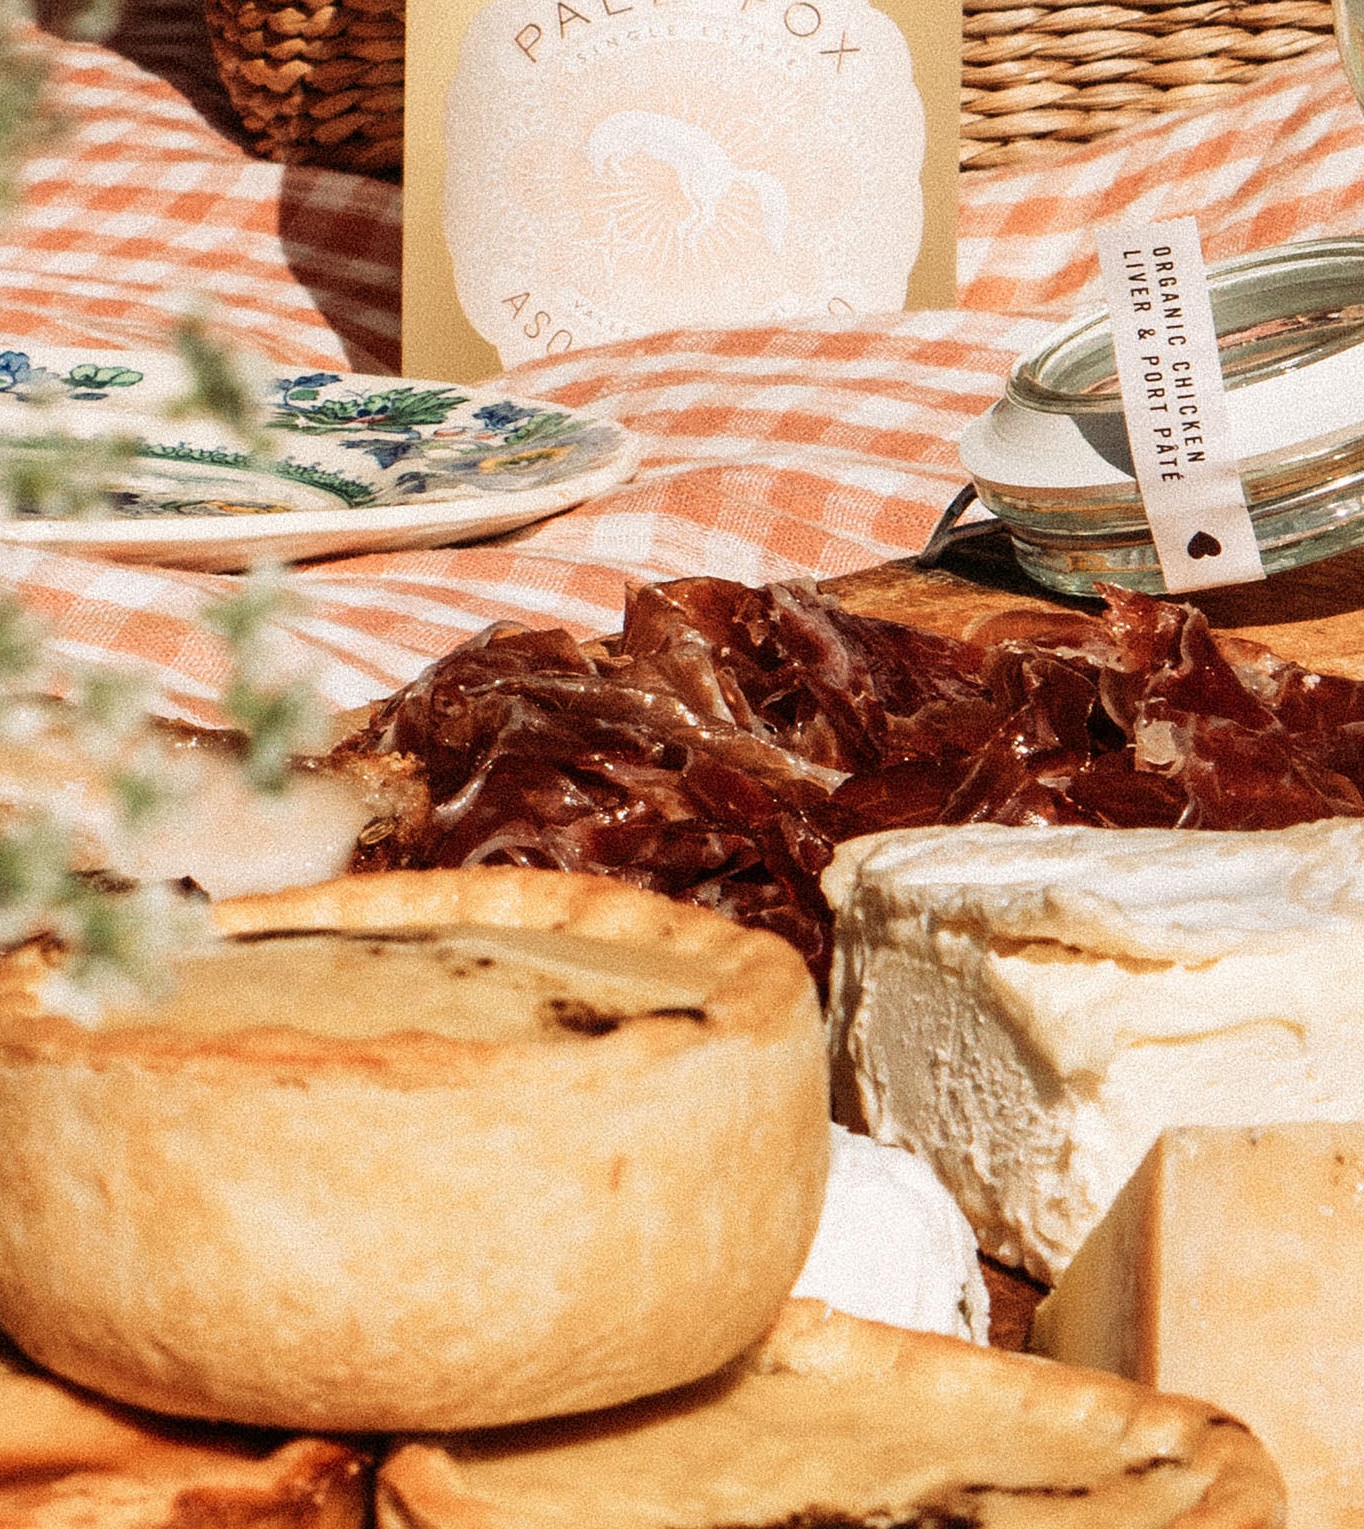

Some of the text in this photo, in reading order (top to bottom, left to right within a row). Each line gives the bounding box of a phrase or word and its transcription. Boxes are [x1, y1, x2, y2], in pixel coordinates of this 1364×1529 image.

[1123, 250, 1184, 483] LIVER & PORT PÂTÉ
[1152, 246, 1205, 463] ORGANIC CHICKEN
